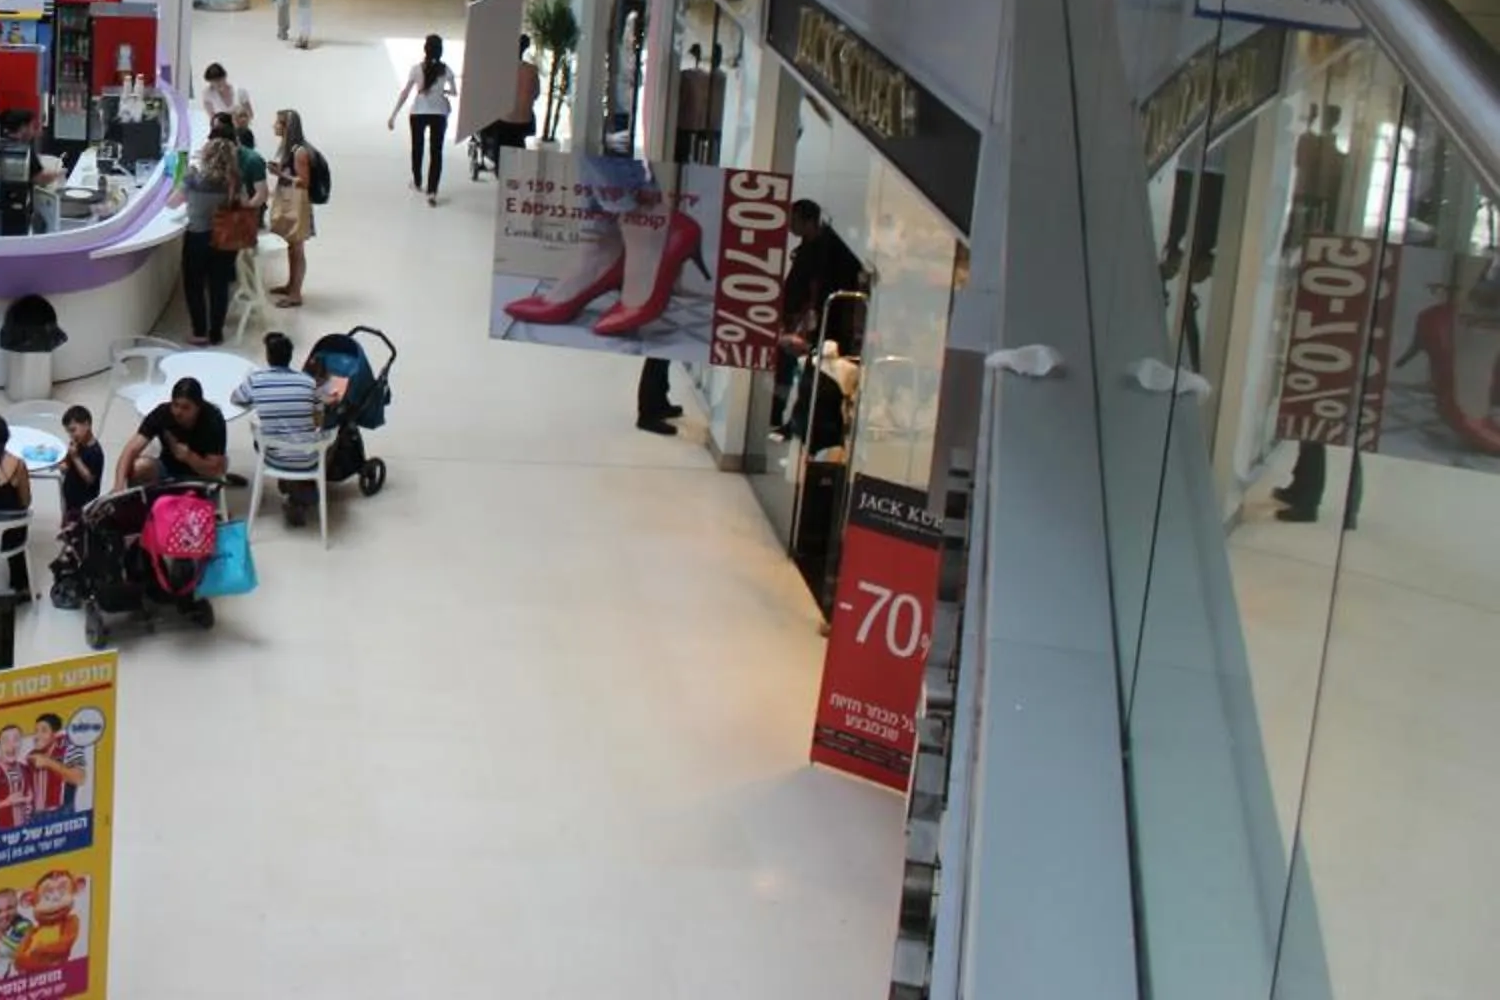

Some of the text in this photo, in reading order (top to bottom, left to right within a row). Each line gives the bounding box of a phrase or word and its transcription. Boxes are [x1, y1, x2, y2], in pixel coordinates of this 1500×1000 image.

[505, 197, 517, 213] E
[715, 171, 790, 342] 50-70%
[713, 341, 777, 371] SALE
[858, 492, 902, 518] JACK
